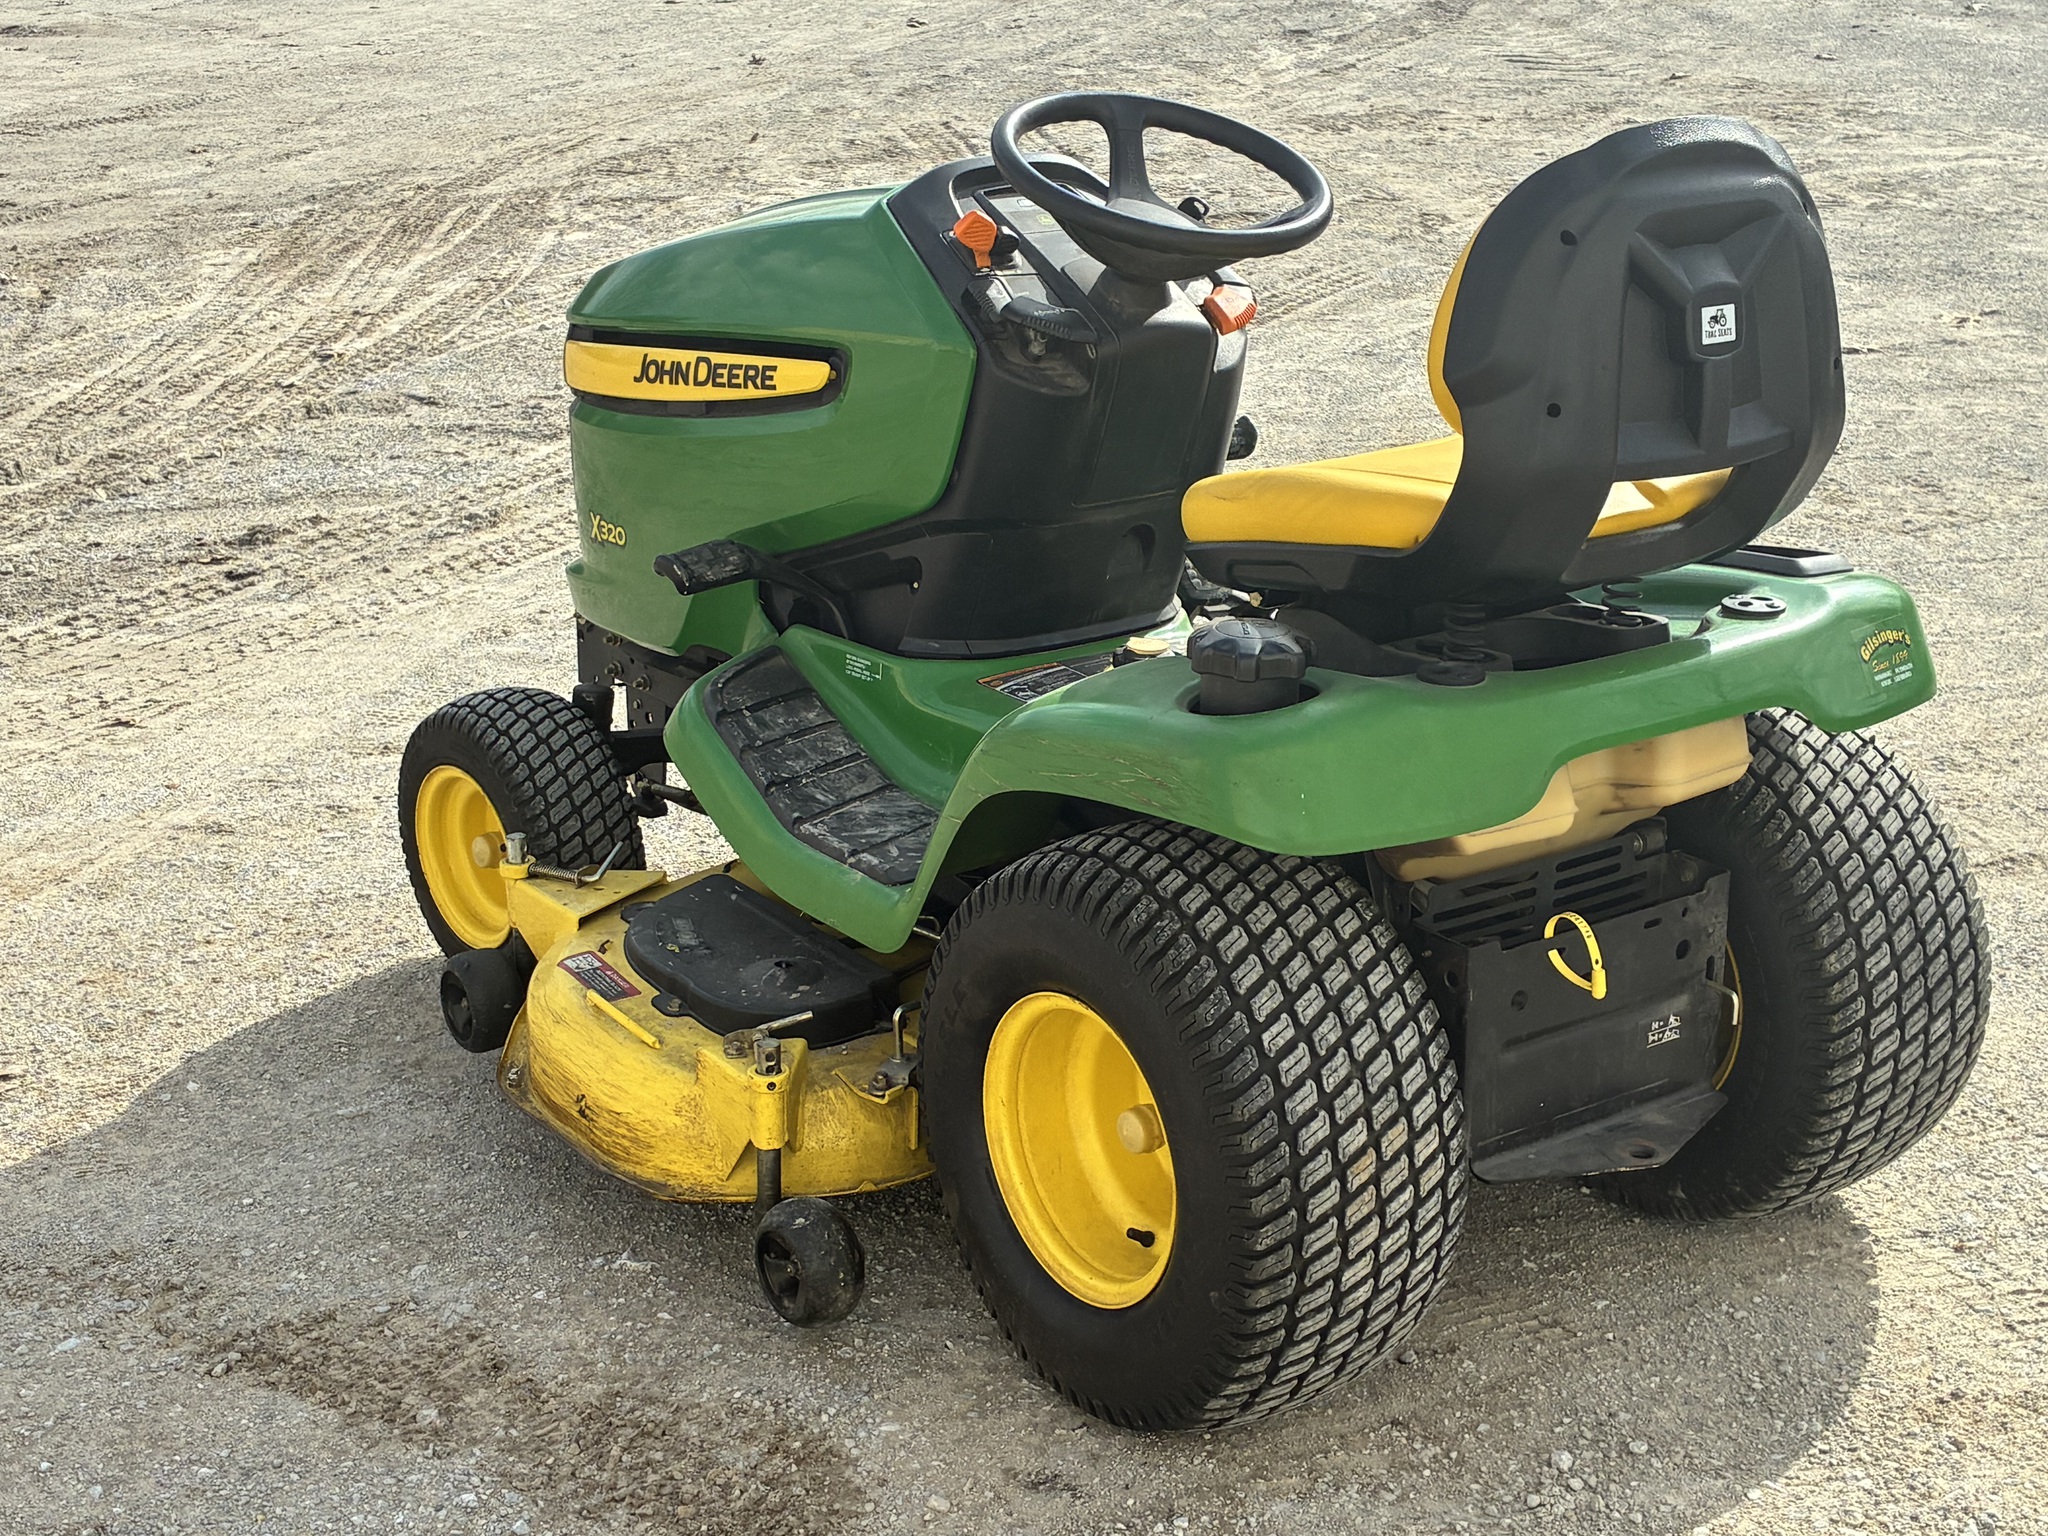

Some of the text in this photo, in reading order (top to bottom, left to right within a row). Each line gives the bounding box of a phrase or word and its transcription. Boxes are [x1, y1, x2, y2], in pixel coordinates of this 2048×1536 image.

[633, 353, 778, 391] JOHN DEERE
[589, 511, 627, 546] X320
[1860, 628, 1912, 662] Gilsinger's
